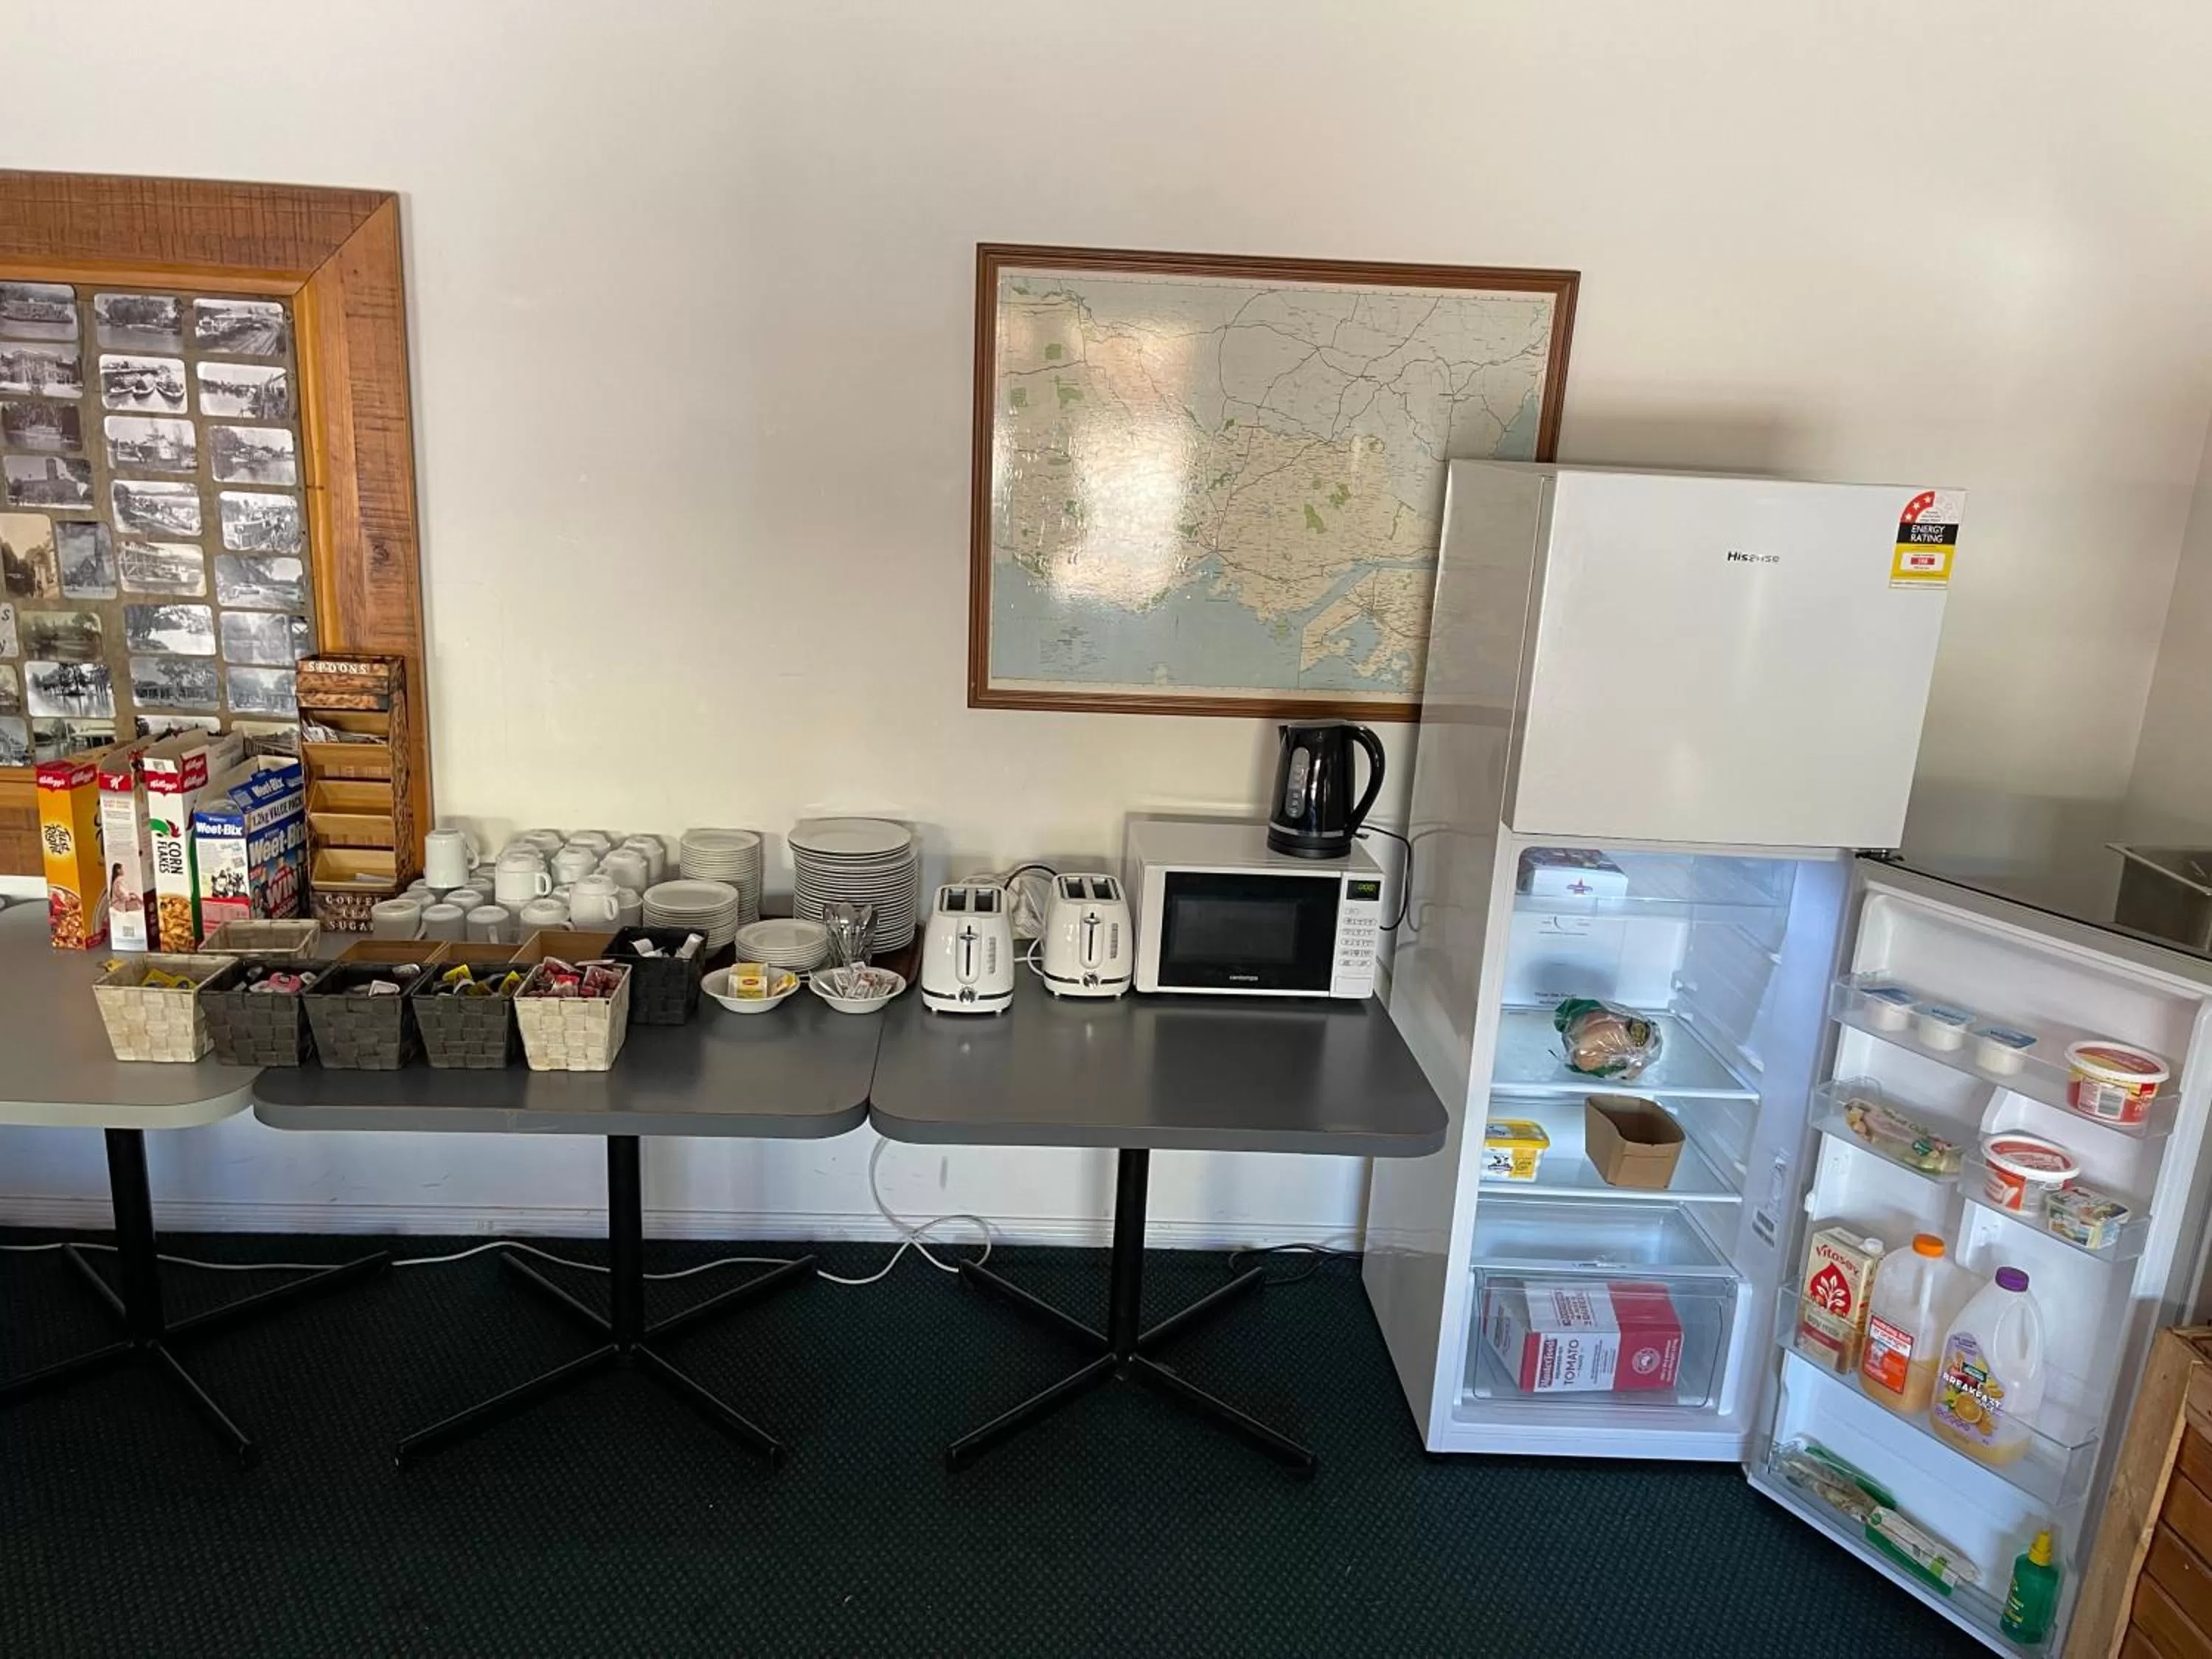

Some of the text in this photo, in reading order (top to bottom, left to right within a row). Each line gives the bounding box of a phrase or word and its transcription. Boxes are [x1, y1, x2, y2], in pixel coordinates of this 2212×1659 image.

[1910, 533, 1943, 543] RATING
[1911, 524, 1944, 534] ENERGY
[1728, 551, 1779, 563] Hisense
[309, 661, 367, 675] SPOONS
[195, 821, 243, 836] Weet-Bix
[157, 841, 170, 874] FLAKES
[168, 842, 184, 875] CORN
[1816, 1244, 1859, 1275] Vitasoy
[1564, 1339, 1579, 1385] TOMATO
[1943, 1372, 2001, 1409] BREAKFAST
